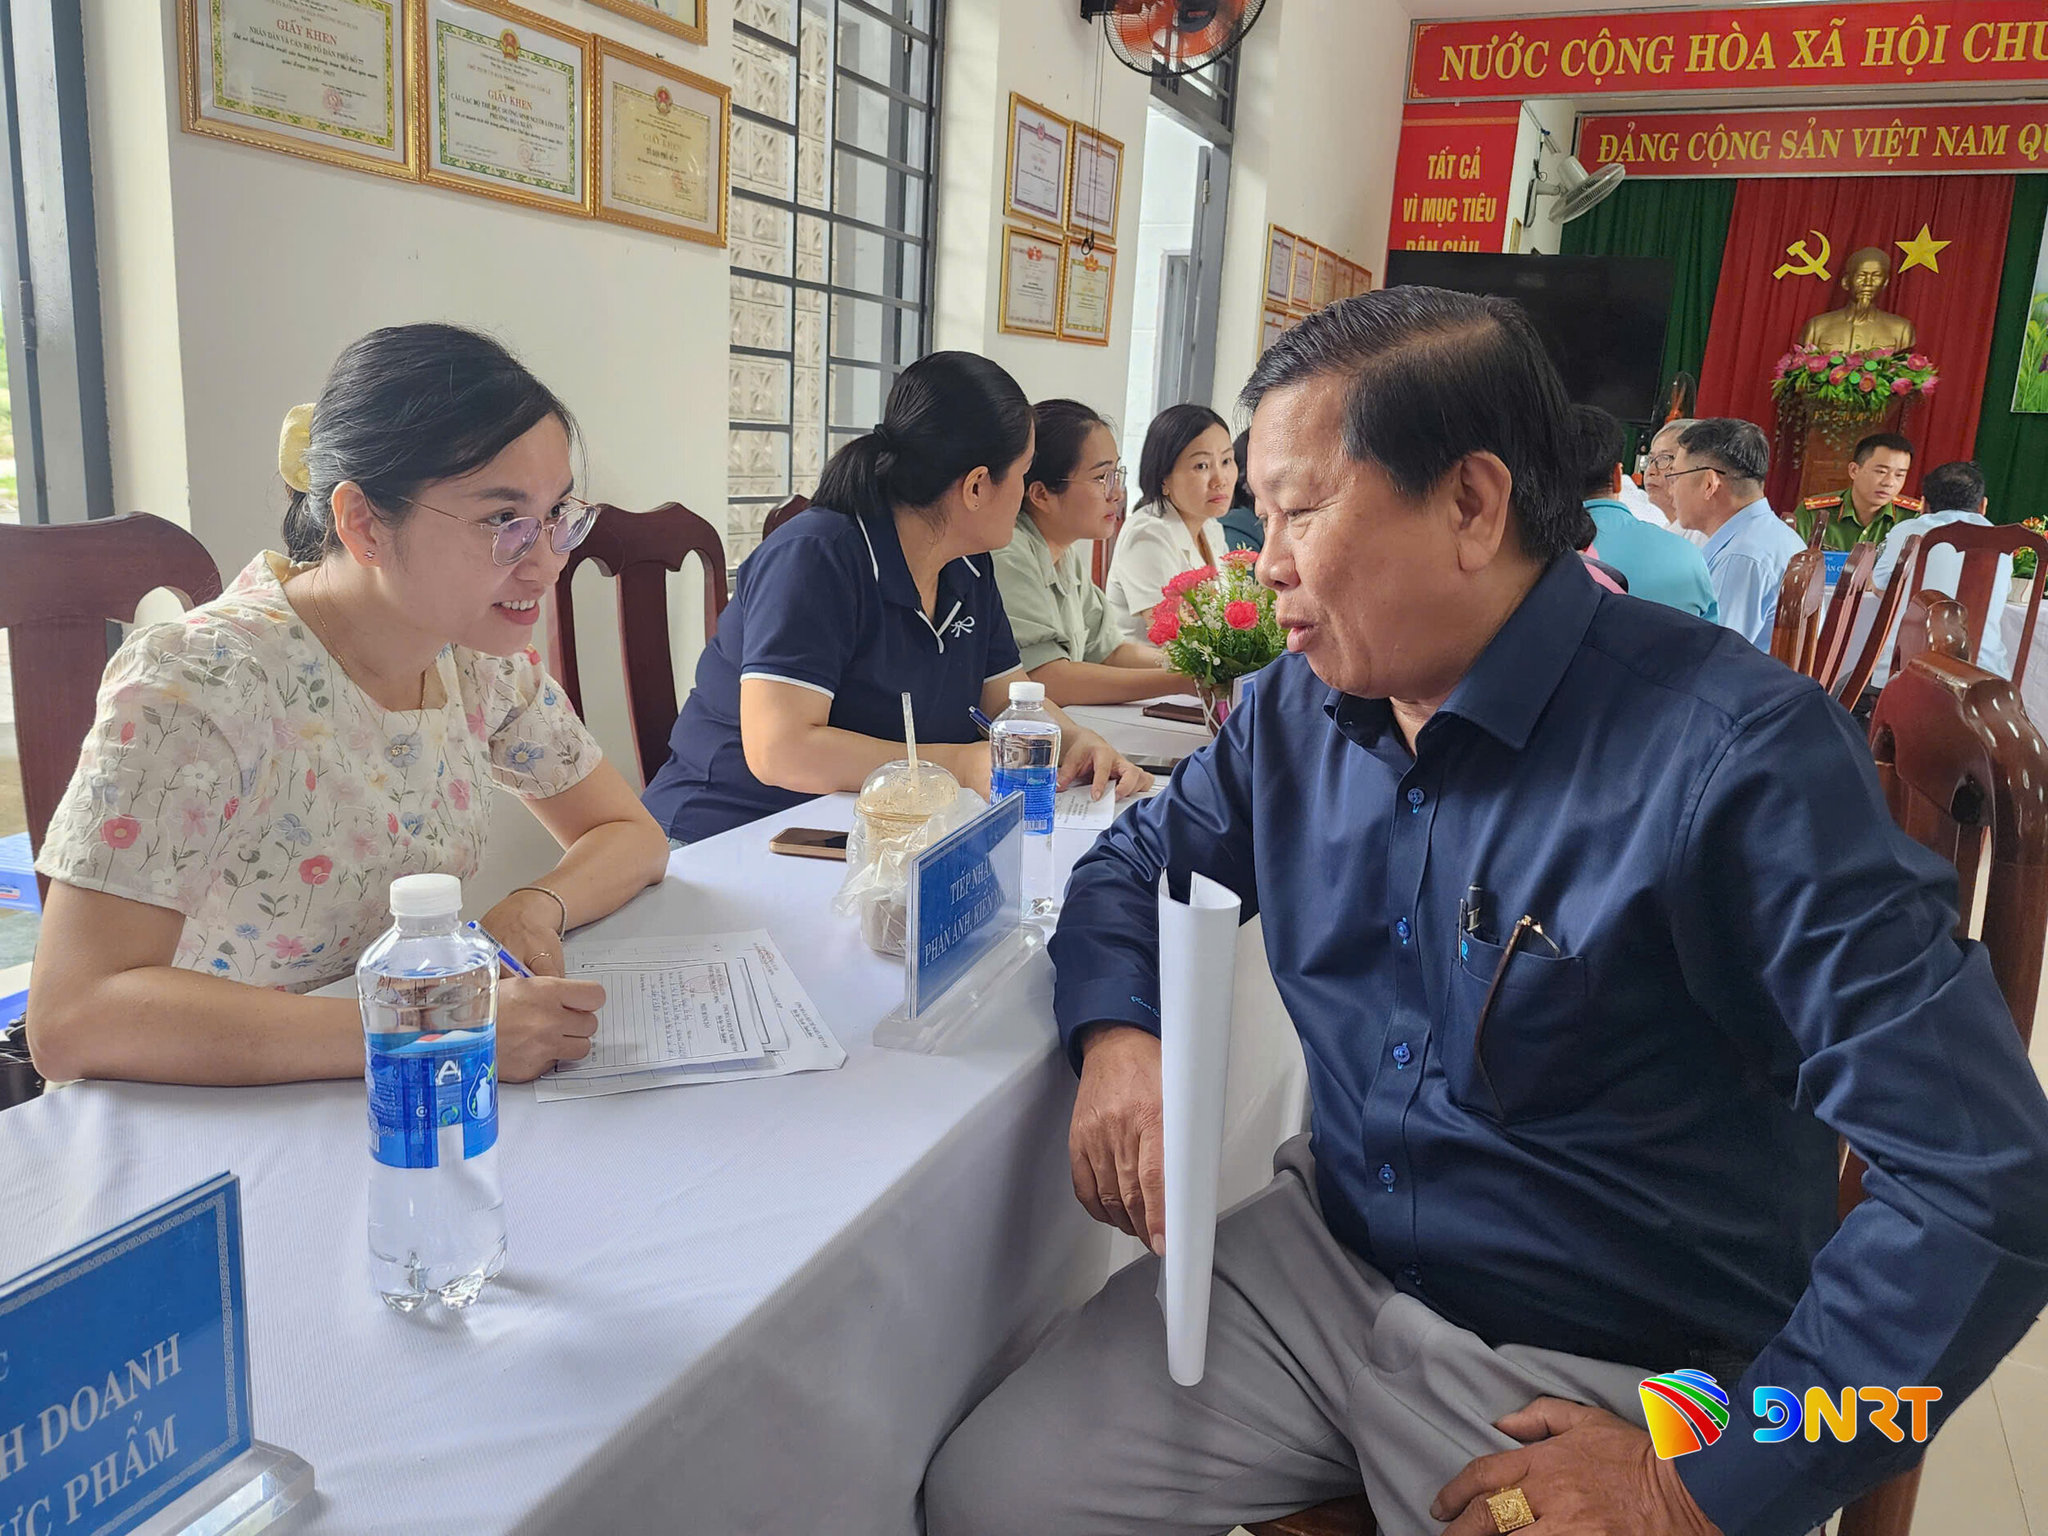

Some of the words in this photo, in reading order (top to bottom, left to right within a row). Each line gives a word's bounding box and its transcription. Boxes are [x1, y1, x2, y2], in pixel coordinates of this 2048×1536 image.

[306, 27, 337, 45] KHEN
[1438, 31, 1550, 82] NƯỚC
[1560, 28, 1675, 86] CỘNG
[1684, 21, 1776, 73] HÒA
[1788, 17, 1847, 68] XÃ
[1860, 14, 1951, 76] HỘI
[1428, 145, 1457, 180] TẤT
[1459, 145, 1481, 180] CẢ
[1597, 121, 1680, 163] ĐẢNG
[1688, 124, 1771, 168] CỘNG
[1778, 116, 1844, 159] SẢN
[1852, 118, 1927, 165] VIỆT
[1932, 124, 2010, 157] NAM
[2018, 123, 2048, 161] Q
[1403, 192, 1418, 222] VÌ
[1421, 197, 1458, 228] MỤC
[1462, 192, 1497, 222] TIÊU
[950, 865, 972, 906] TIẾP
[37, 1332, 183, 1456] DOANH
[62, 1410, 180, 1526] PHẨM
